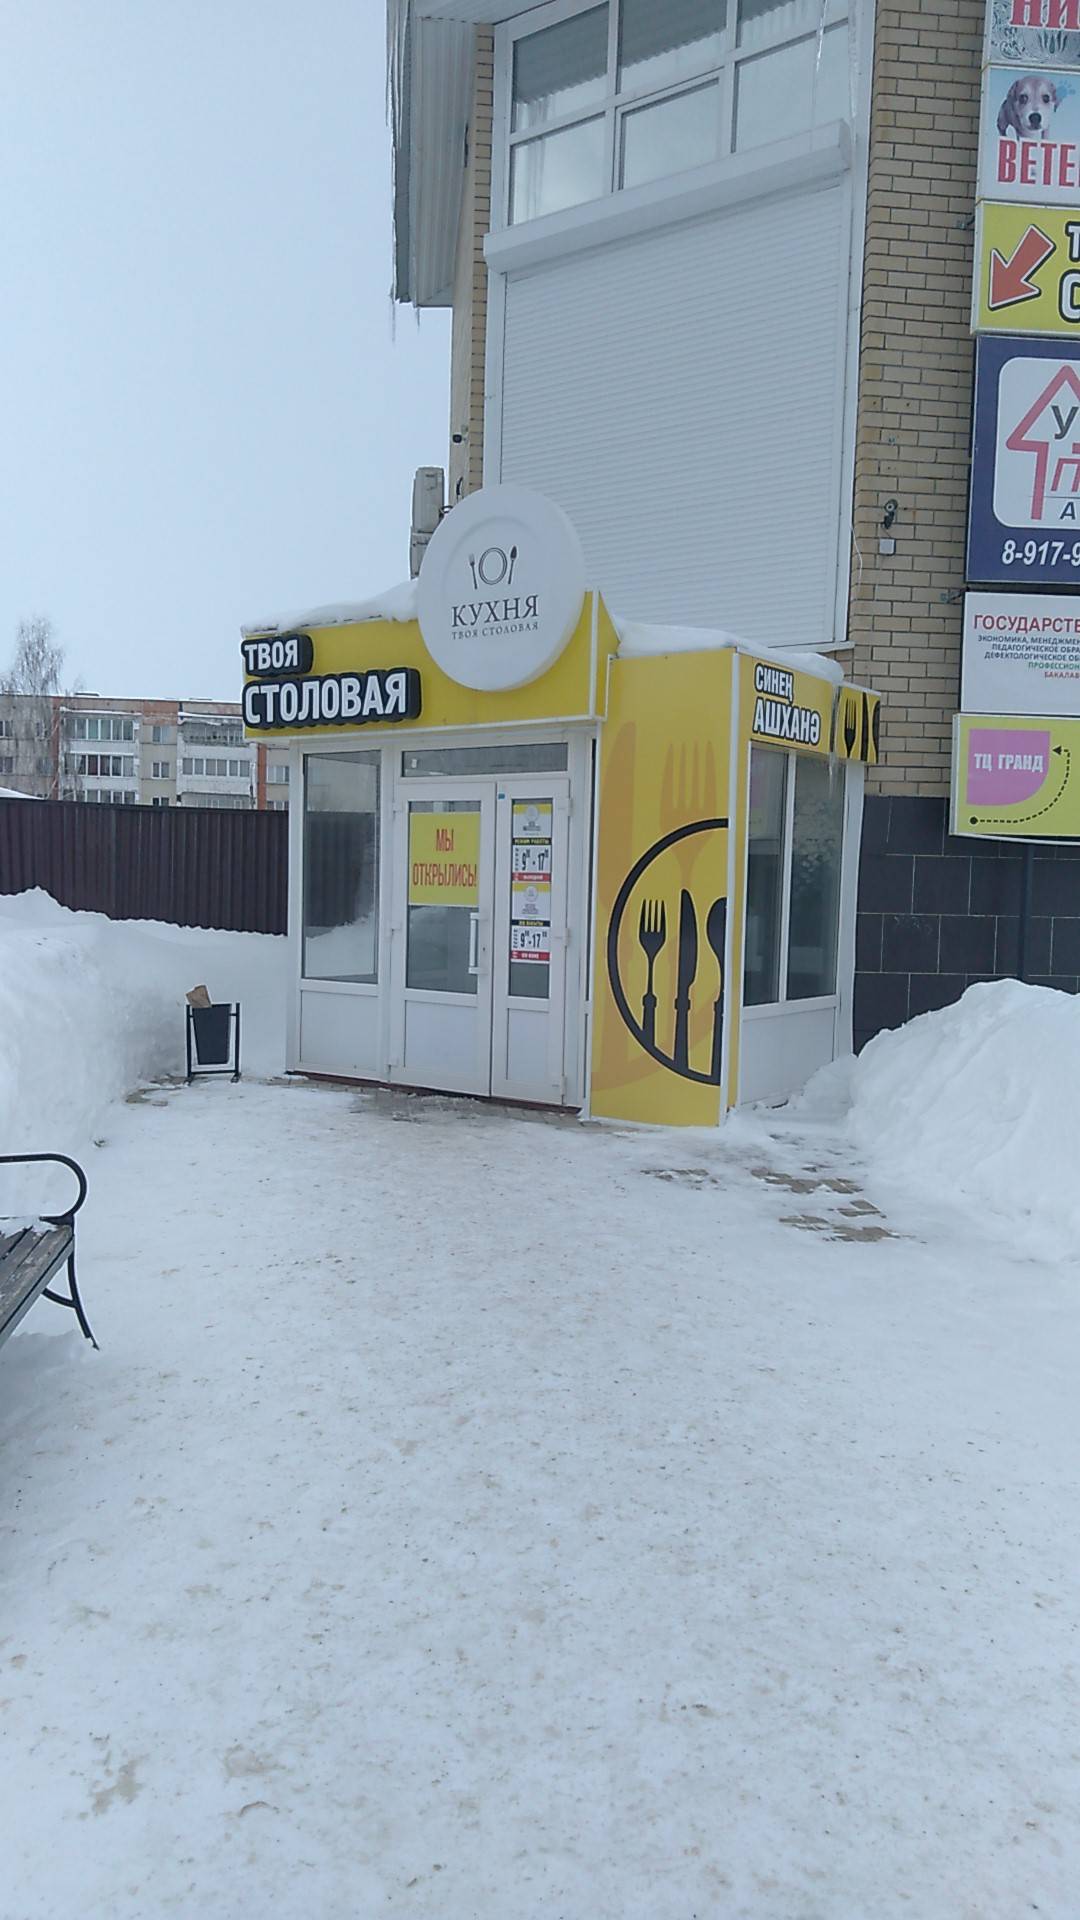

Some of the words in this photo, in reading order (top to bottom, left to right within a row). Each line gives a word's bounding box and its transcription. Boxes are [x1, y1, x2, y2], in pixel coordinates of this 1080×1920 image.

[998, 139, 1080, 188] ВЕТЕ
[1002, 539, 1080, 567] 8-917-9
[451, 595, 539, 627] КУХНЯ
[452, 629, 479, 640] ТВОЯ
[482, 622, 538, 637] СТОЛОВАЯ
[978, 635, 1029, 645] ЭКОНОМИКА,
[244, 639, 298, 671] ТВОЯ
[984, 651, 1066, 661] ДЕФЕКТОЛОГИЧЕСКОЕ
[992, 643, 1058, 653] ПЕДАГОГИЧЕСКОЕ
[756, 665, 793, 702] СИНЕҢ
[245, 672, 406, 724] СТОЛОВАЯ
[753, 699, 820, 744] АШХАНӘ
[974, 753, 992, 772] ТЦ
[998, 754, 1043, 773] ГРАНД
[436, 829, 454, 851] МЫ
[413, 863, 477, 887] ОТКРЫЛИСЬ!
